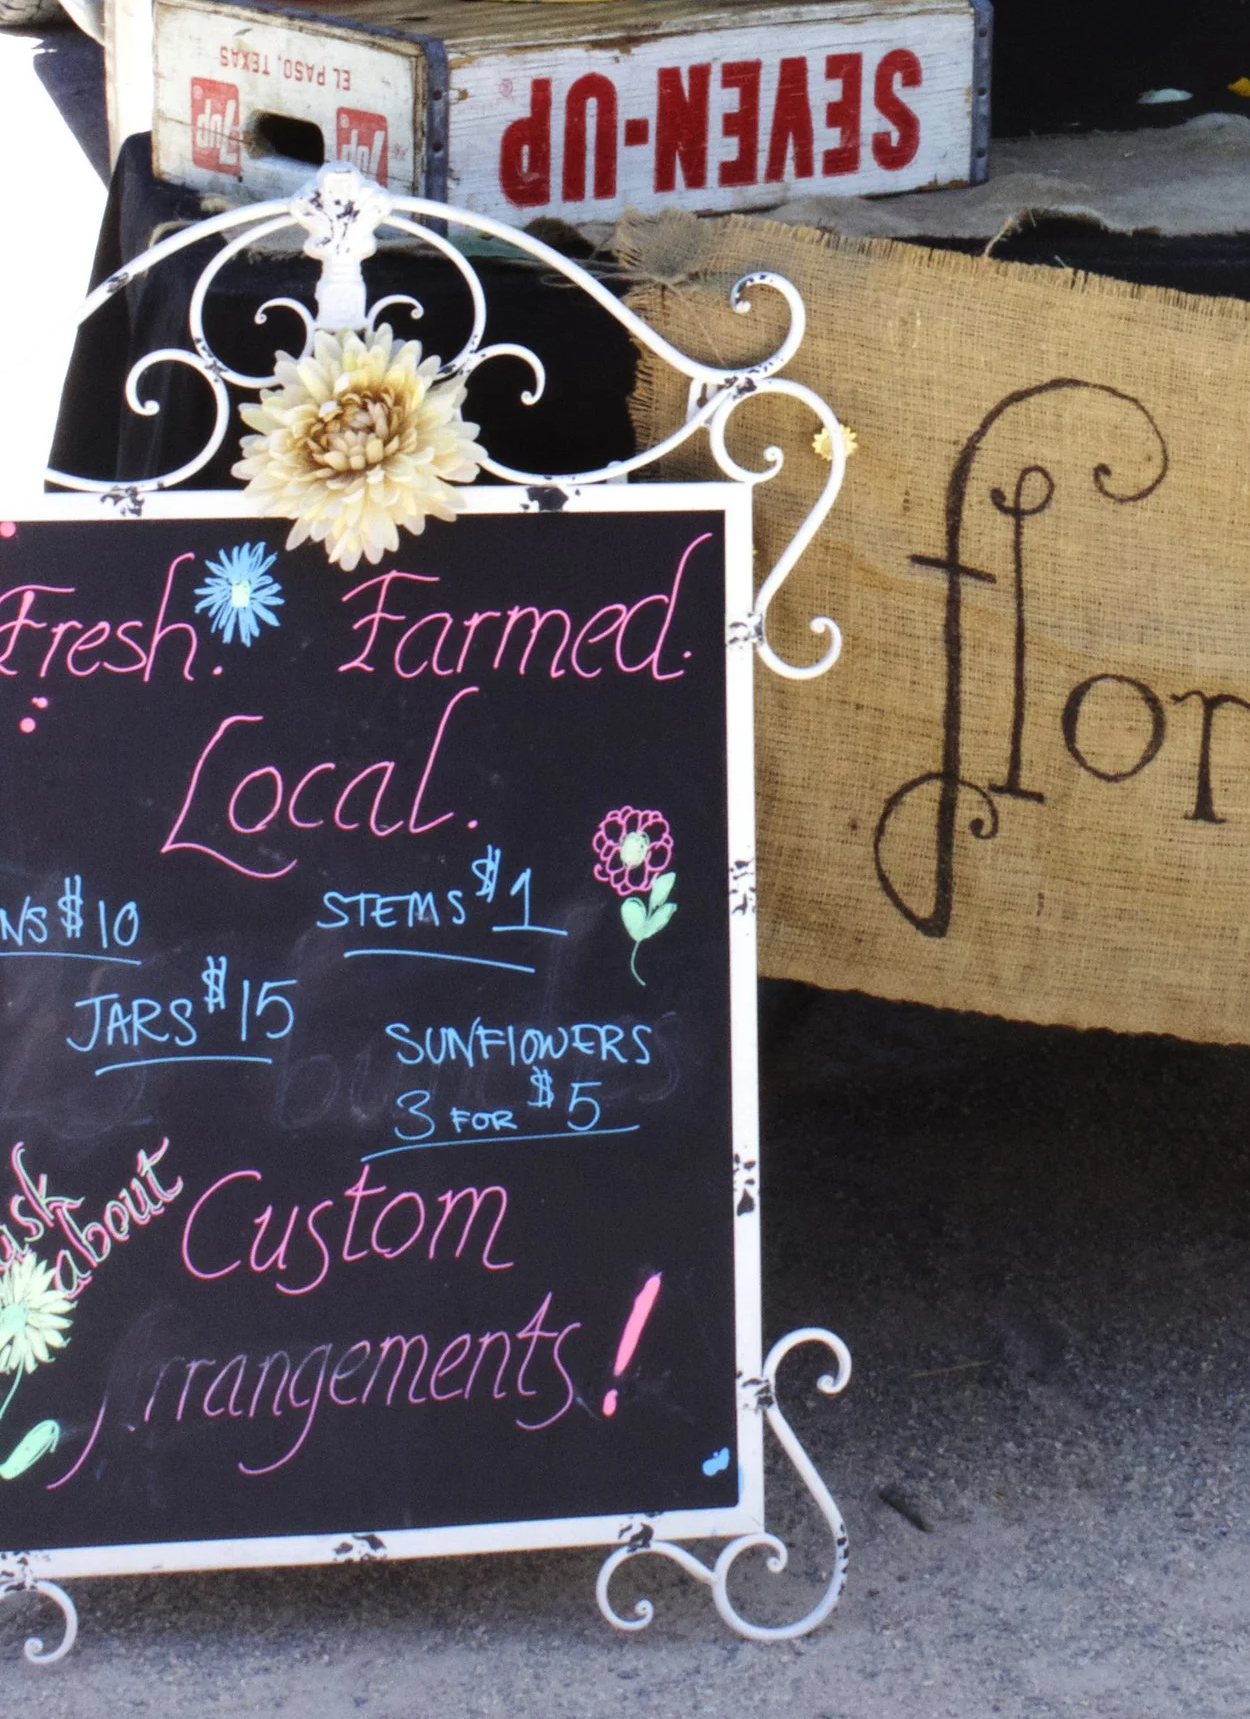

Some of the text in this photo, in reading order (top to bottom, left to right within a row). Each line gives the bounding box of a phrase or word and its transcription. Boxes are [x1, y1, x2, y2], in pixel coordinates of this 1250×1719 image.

[218, 45, 352, 91] EL PASO, TEXAS
[499, 47, 924, 208] SEVEN-UP
[338, 533, 713, 683] Farmed.
[160, 686, 481, 879] Local.
[57, 874, 140, 949] $10
[315, 890, 466, 929] STEMS
[66, 954, 299, 1053] JARS $15
[394, 1089, 436, 1141] 3
[449, 1106, 518, 1134] FOR
[54, 1135, 184, 1301] about
[181, 1164, 515, 1295] Custom
